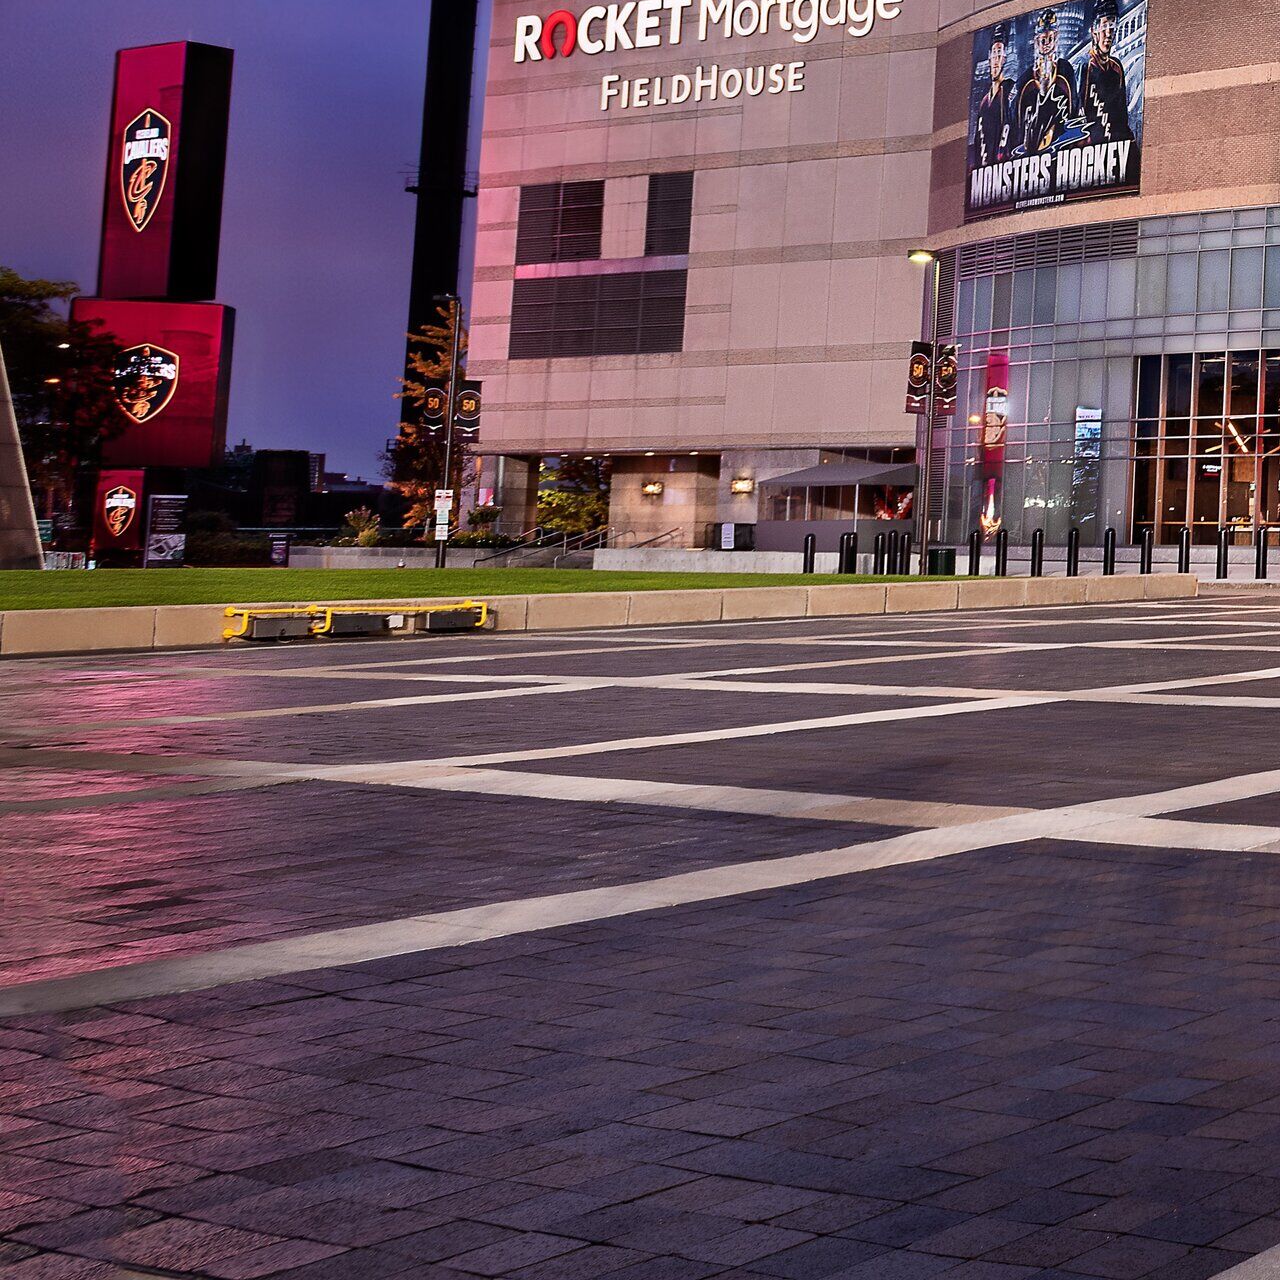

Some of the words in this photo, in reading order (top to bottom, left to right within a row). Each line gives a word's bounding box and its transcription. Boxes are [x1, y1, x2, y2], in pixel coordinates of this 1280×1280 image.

[971, 153, 1051, 209] MONSTERS
[1055, 140, 1132, 192] HOCKEY
[913, 363, 924, 377] 50
[428, 397, 440, 409] 50
[462, 399, 476, 412] 50
